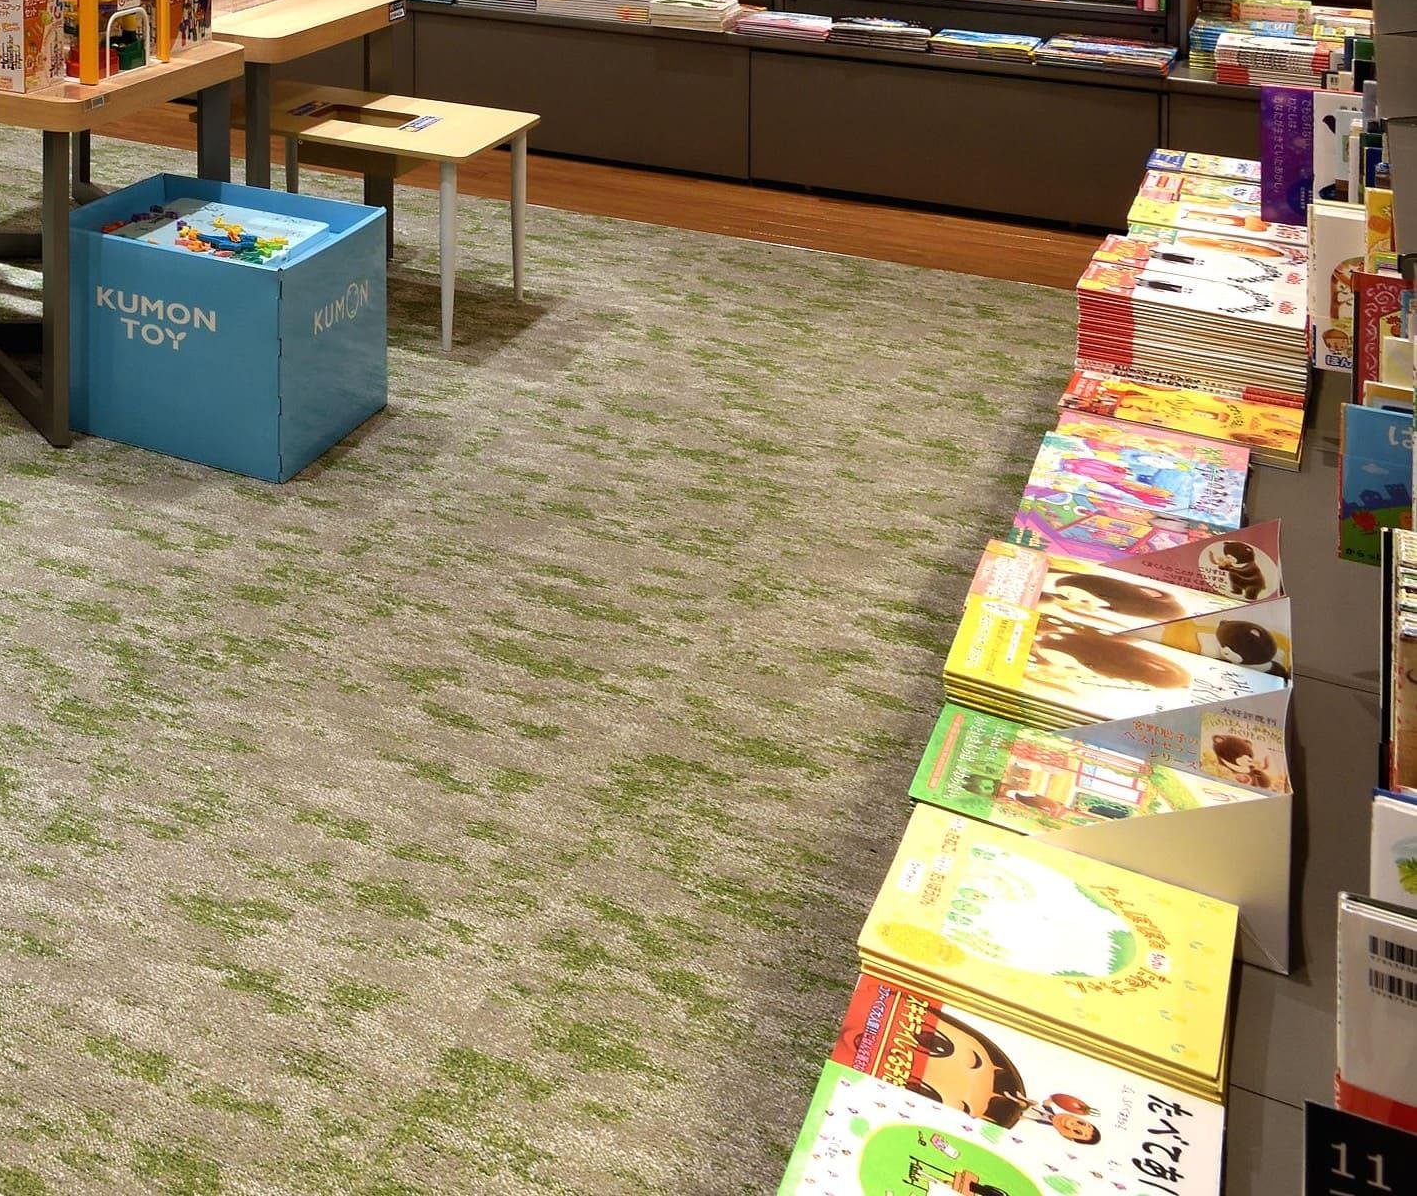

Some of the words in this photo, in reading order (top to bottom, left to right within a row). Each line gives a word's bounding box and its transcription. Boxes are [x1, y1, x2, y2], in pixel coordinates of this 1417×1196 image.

[96, 286, 217, 333] KUMON
[314, 280, 369, 335] KUMON
[121, 318, 187, 351] TOY
[1330, 1141, 1392, 1191] 11
